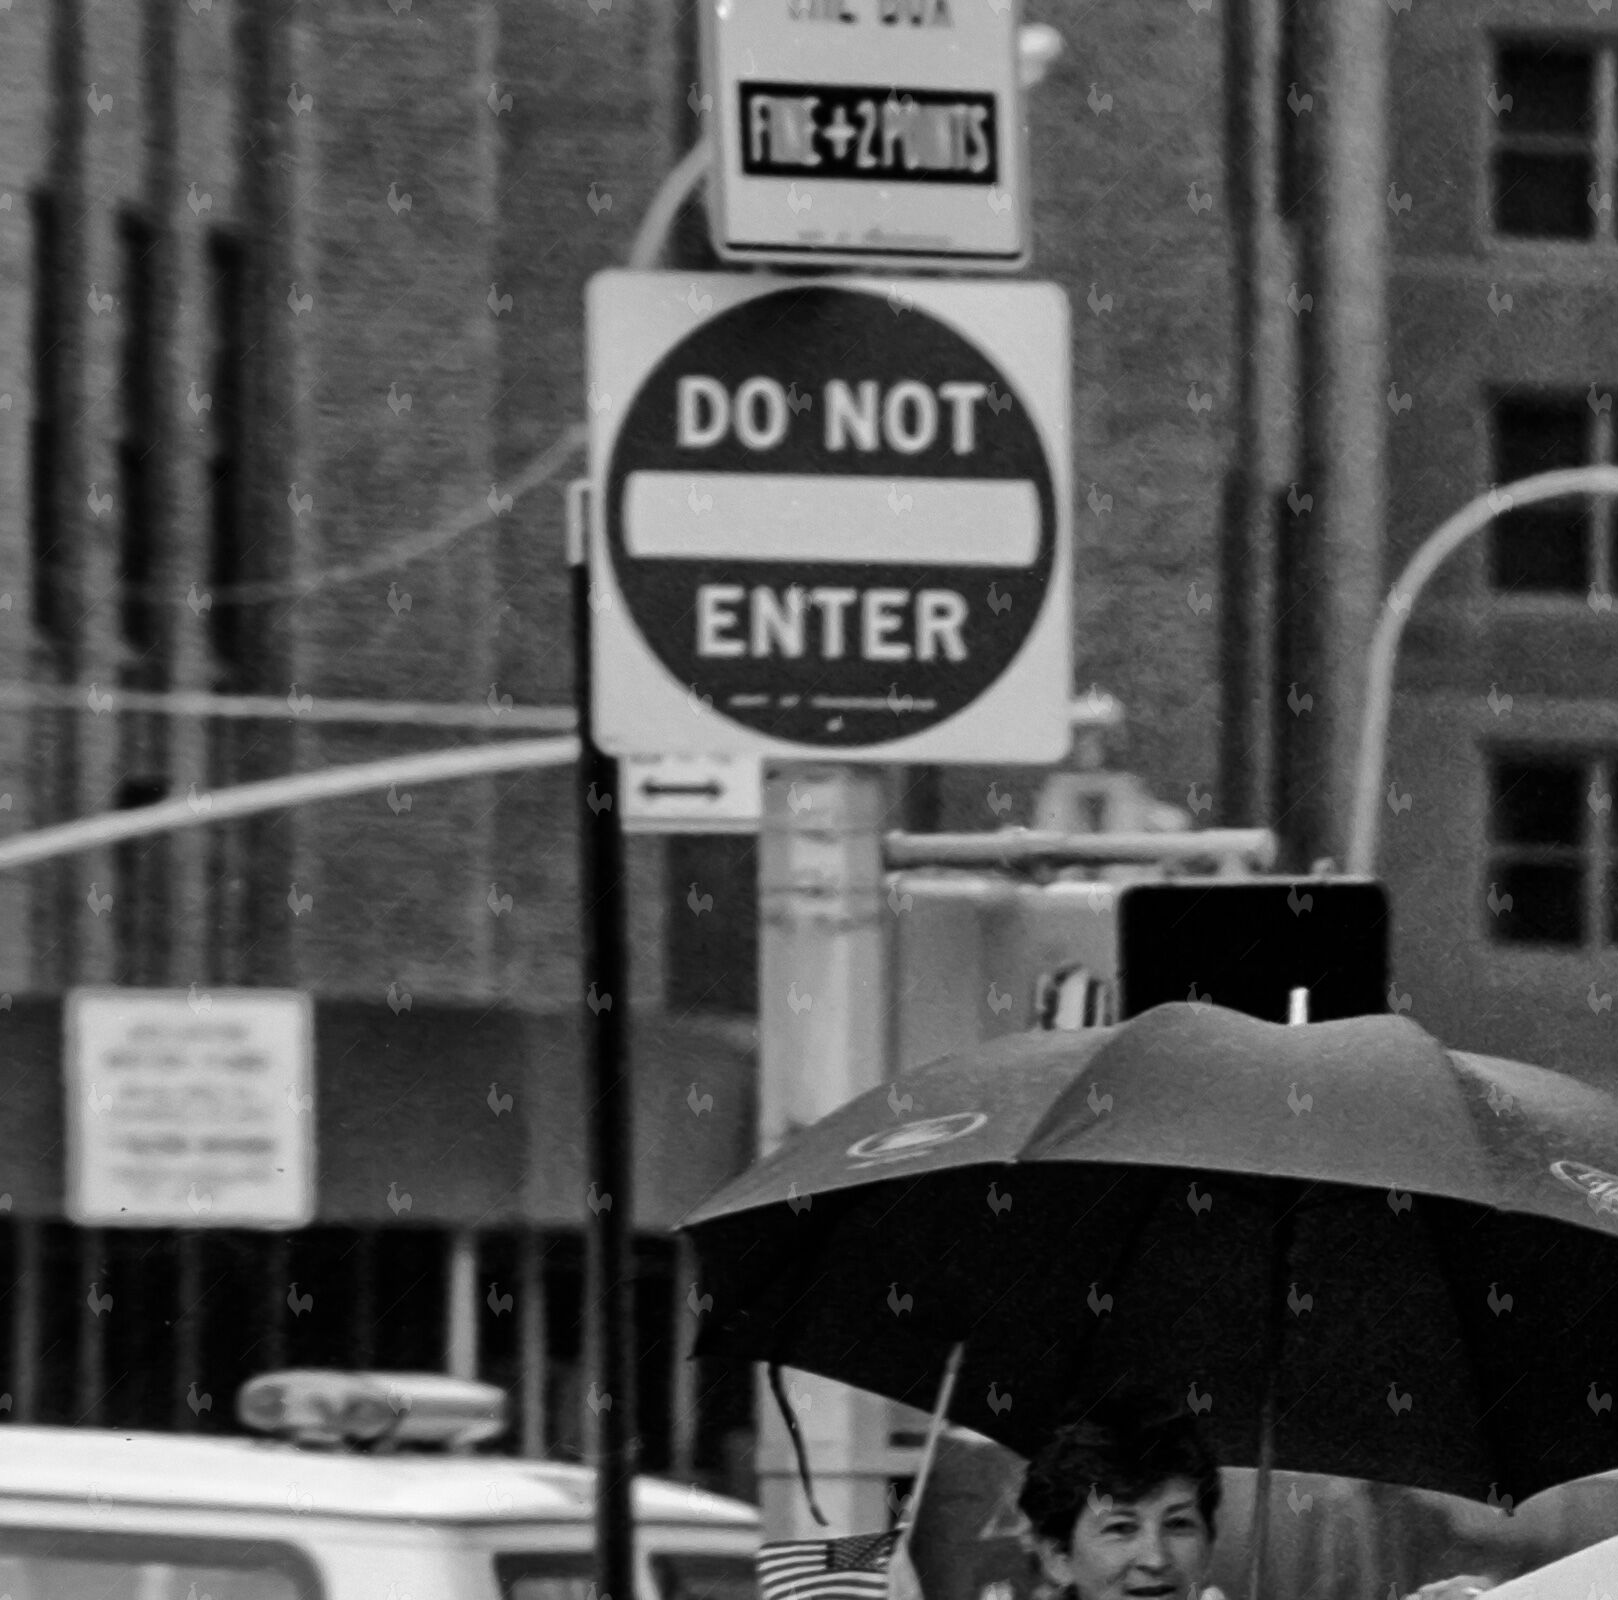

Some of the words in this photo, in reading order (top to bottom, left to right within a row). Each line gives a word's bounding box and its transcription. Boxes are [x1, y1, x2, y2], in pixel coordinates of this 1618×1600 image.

[676, 375, 789, 449] DO
[823, 378, 986, 454] NOT
[696, 585, 968, 661] ENTER
